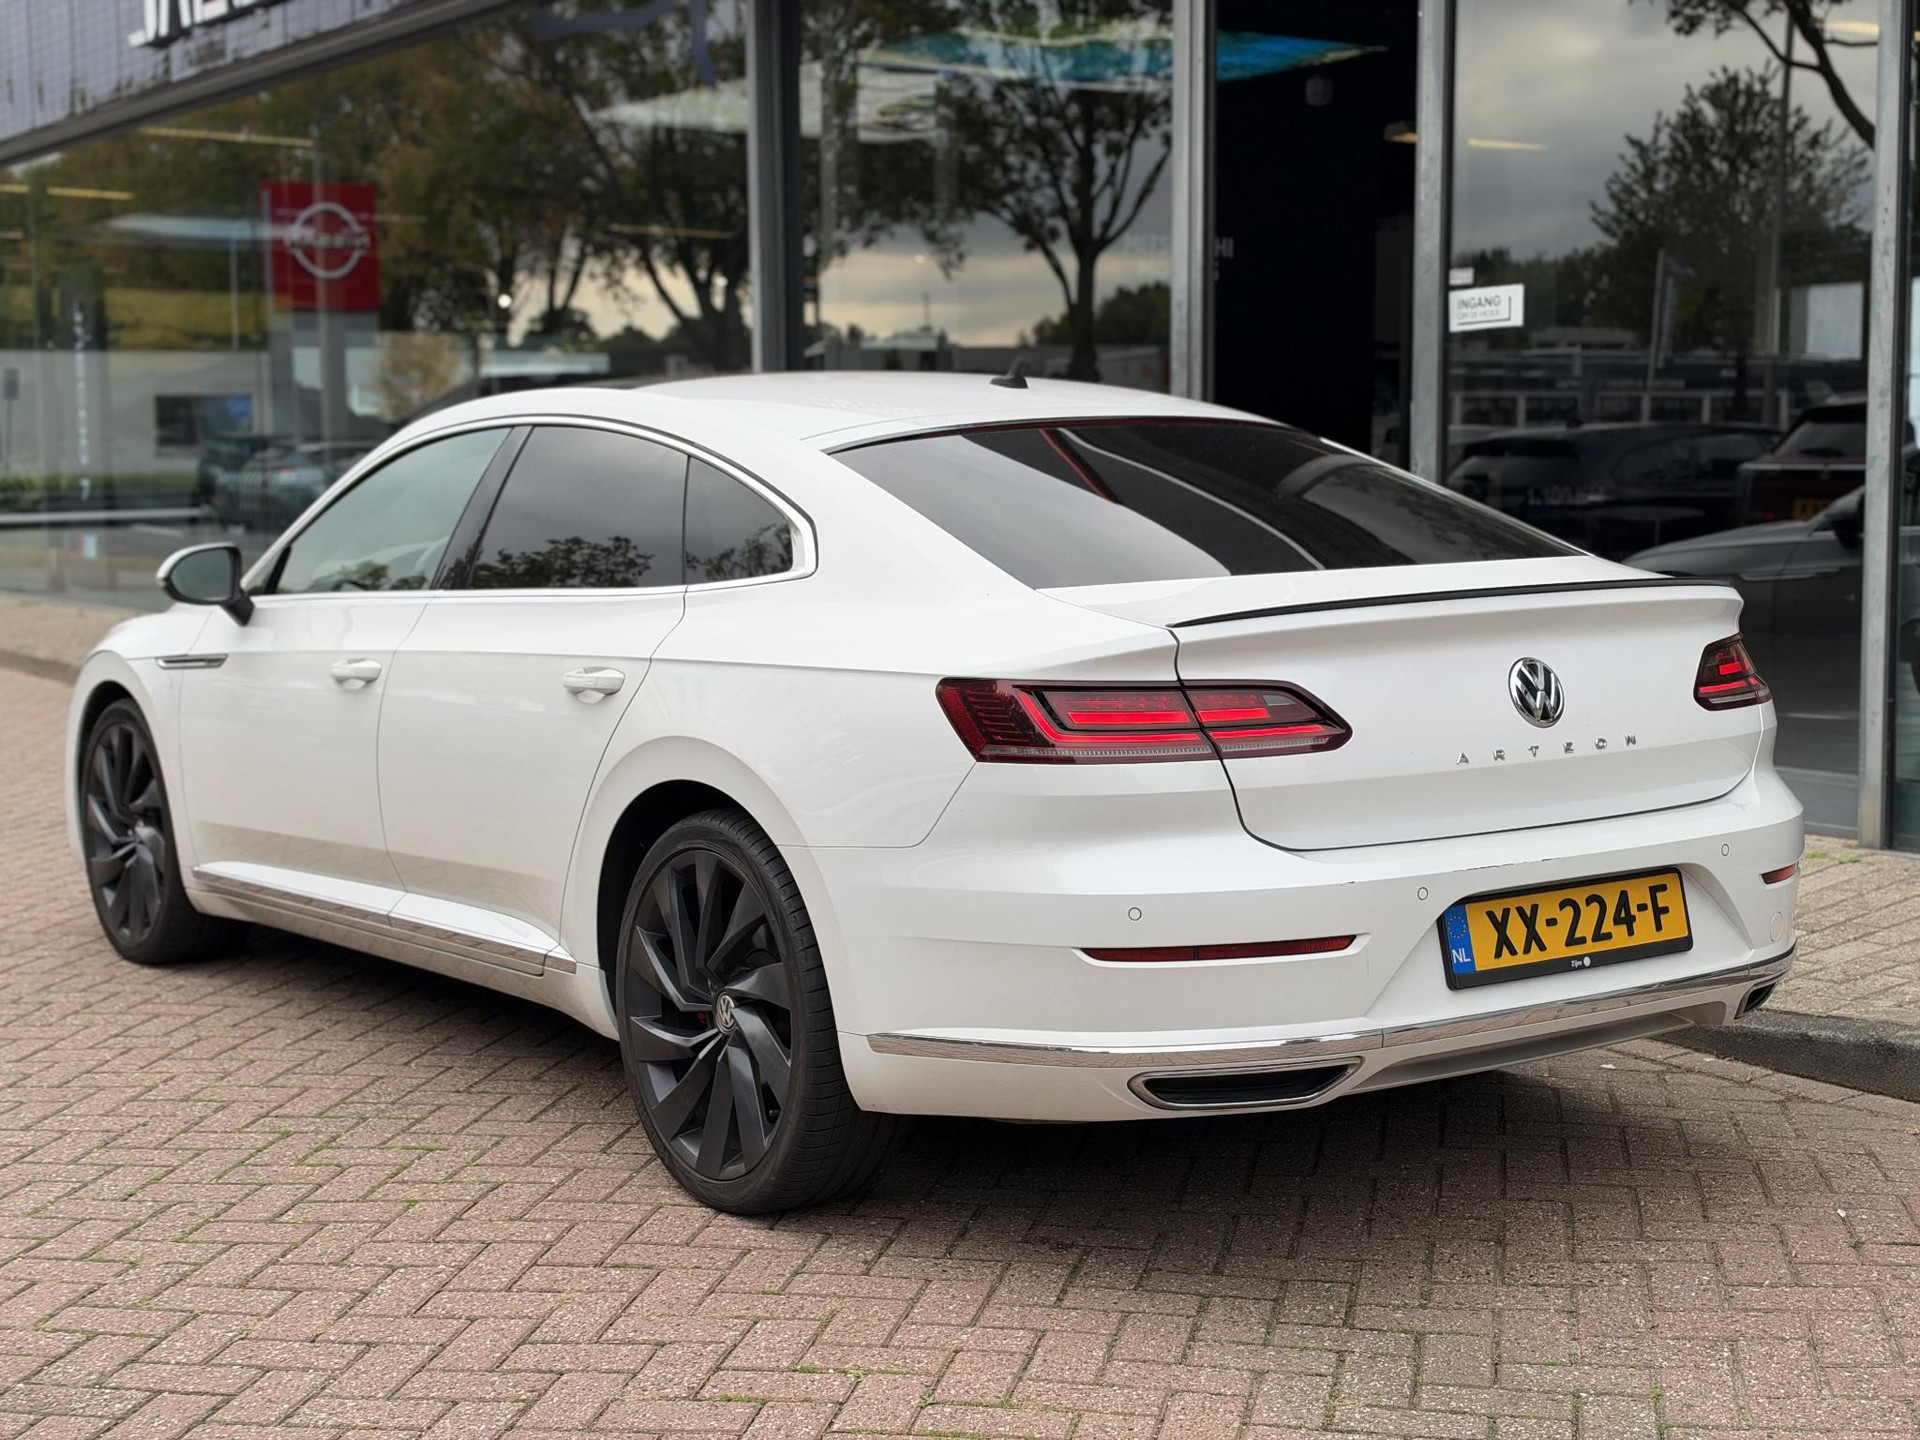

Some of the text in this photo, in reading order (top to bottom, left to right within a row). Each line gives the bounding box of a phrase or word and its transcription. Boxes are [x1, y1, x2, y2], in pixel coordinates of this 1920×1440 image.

[1457, 294, 1501, 310] INGANG
[1456, 735, 1637, 765] ARTEON
[1485, 883, 1670, 959] XX-224-F
[1452, 948, 1471, 963] NL
